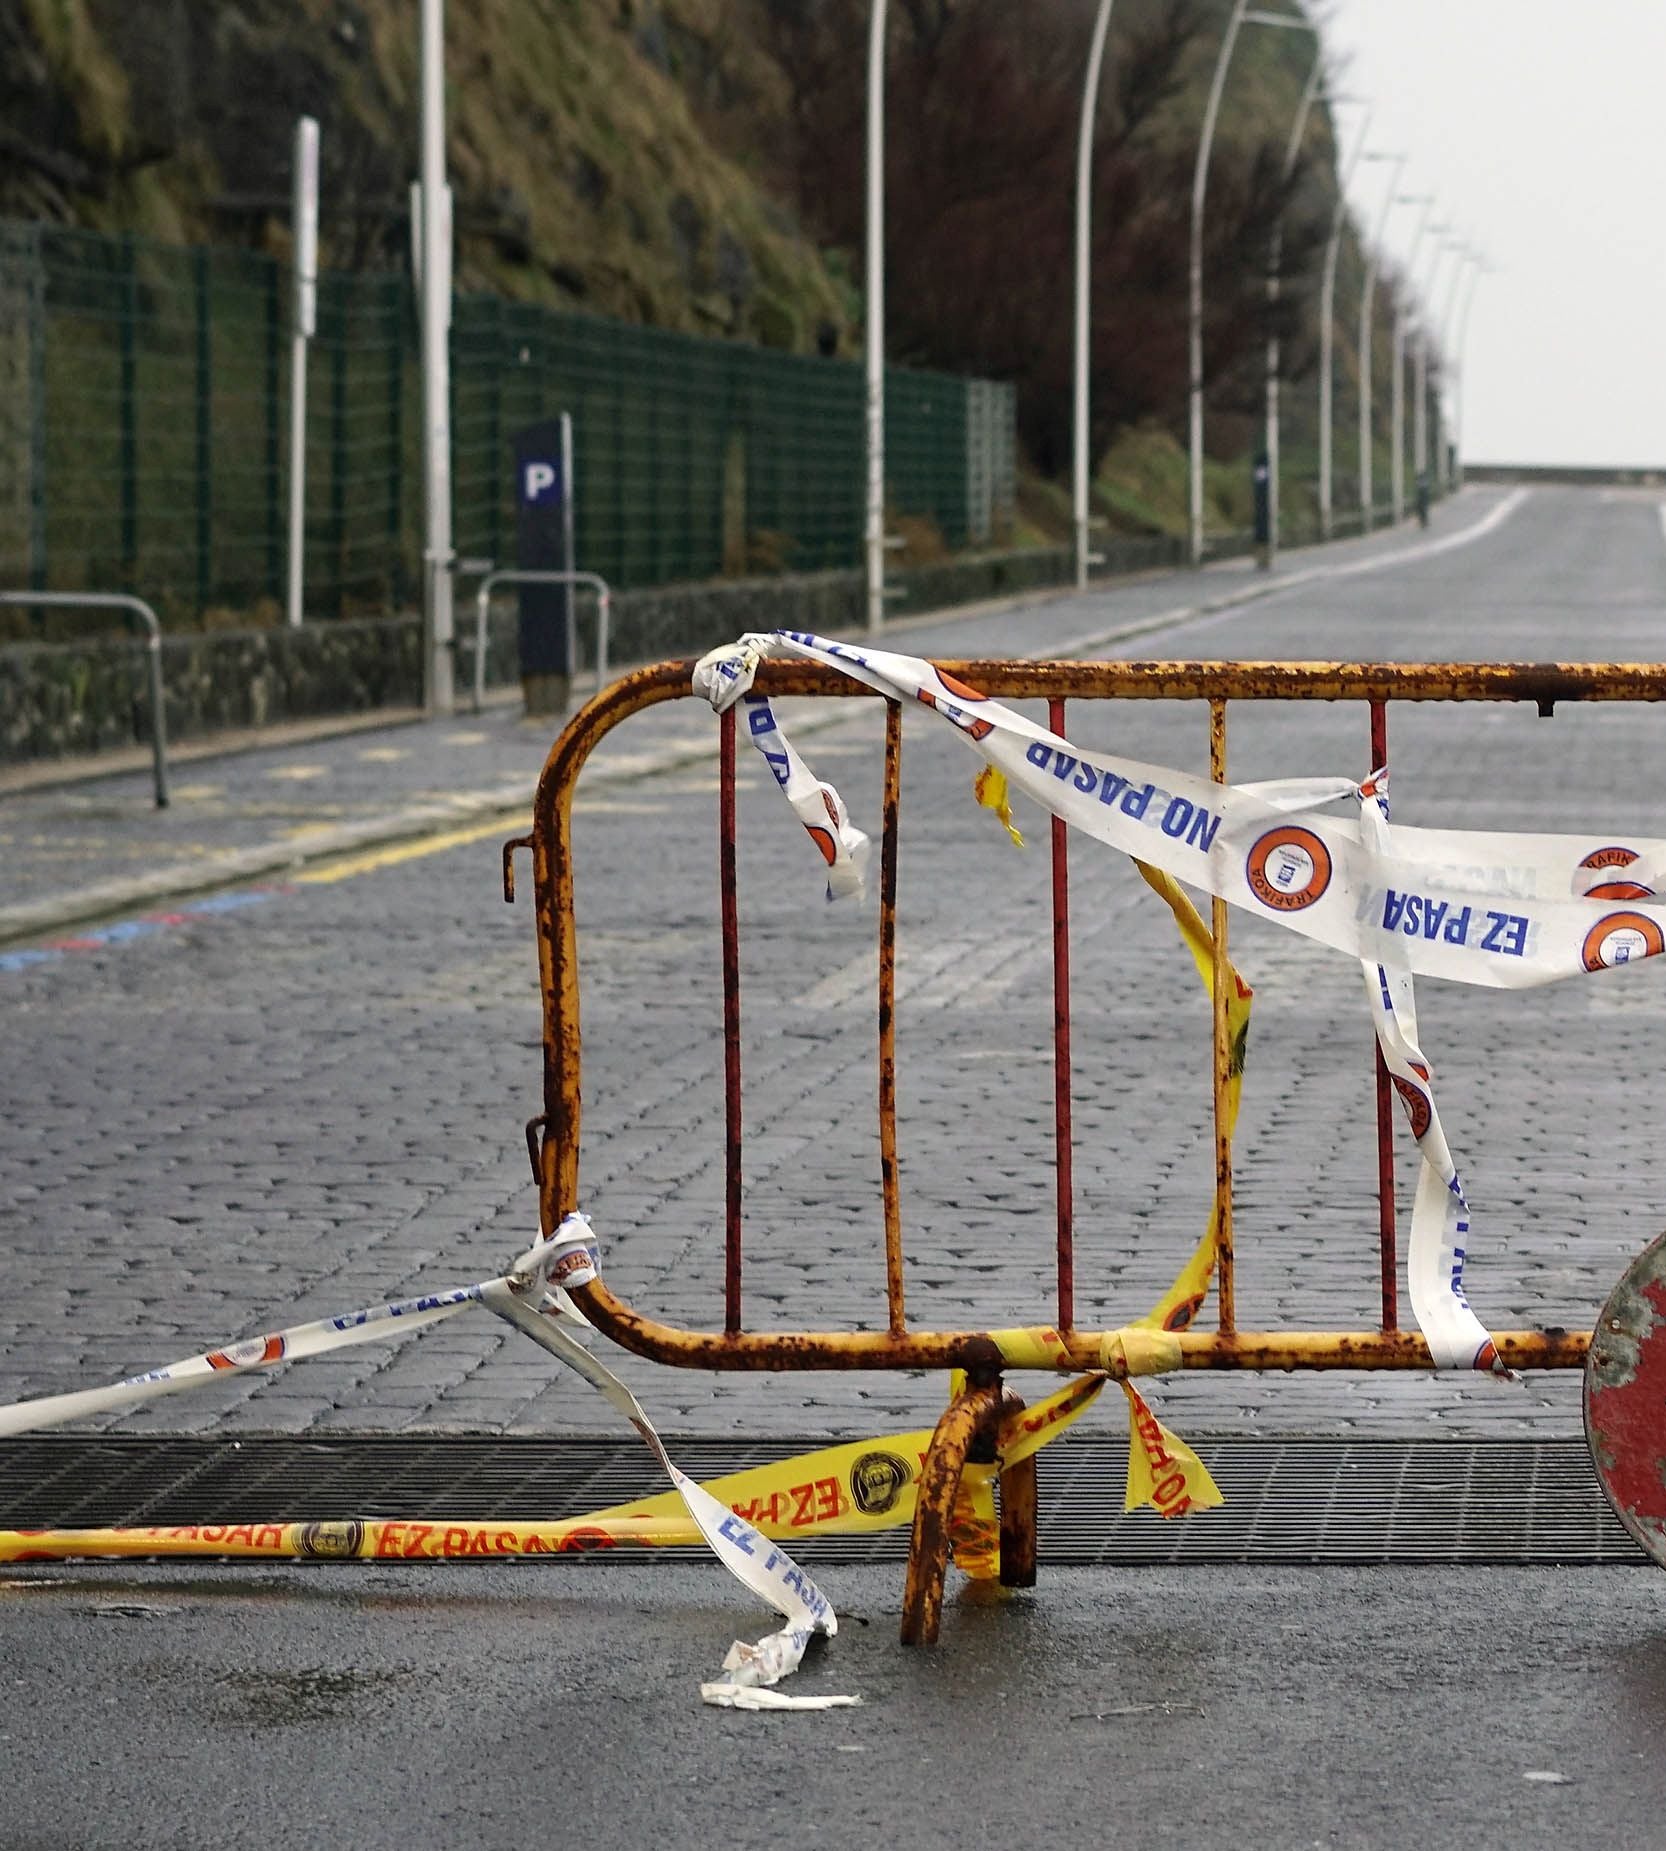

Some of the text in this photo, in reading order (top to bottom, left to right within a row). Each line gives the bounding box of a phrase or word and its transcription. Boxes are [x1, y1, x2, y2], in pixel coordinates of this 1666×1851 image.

[525, 461, 556, 500] P
[1161, 796, 1222, 853] NO
[1382, 888, 1529, 957] EZ PASA
[790, 1476, 841, 1527] EZ
[376, 1522, 433, 1558] EZ
